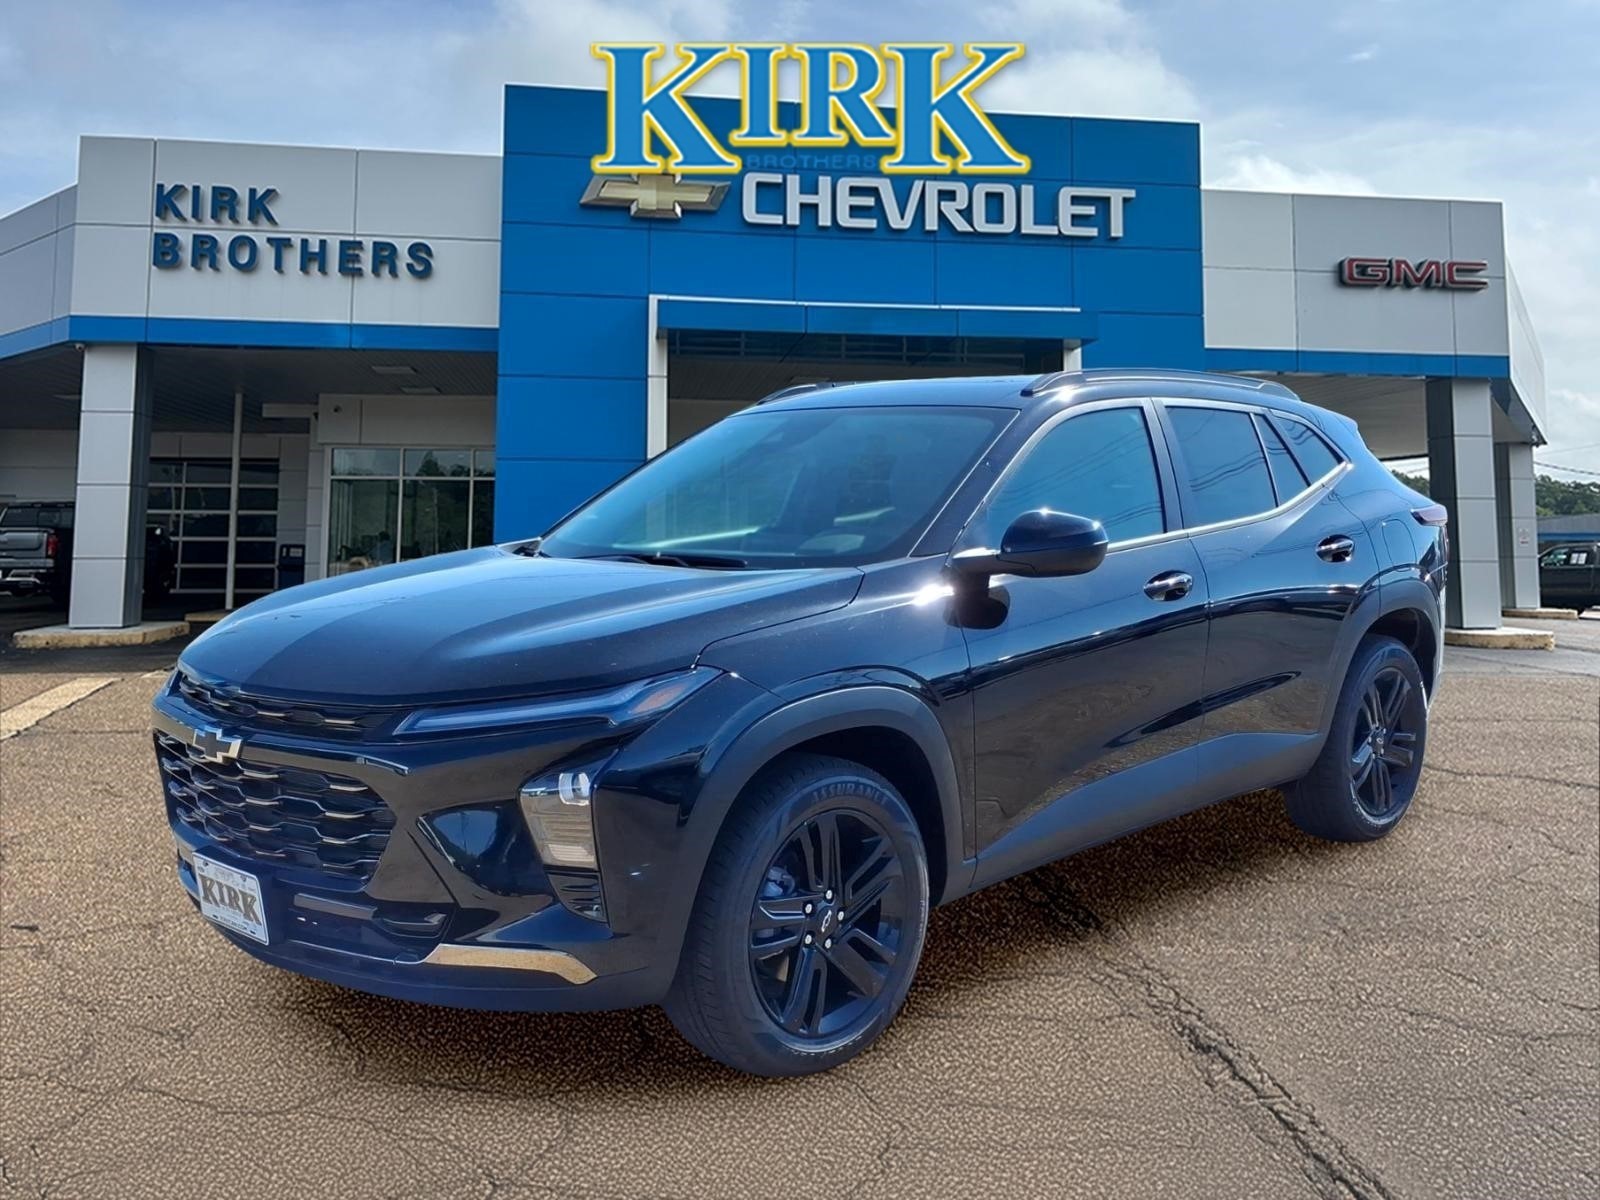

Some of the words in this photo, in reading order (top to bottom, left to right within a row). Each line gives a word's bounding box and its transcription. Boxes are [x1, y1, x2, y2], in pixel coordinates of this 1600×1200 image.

[154, 183, 279, 226] KIRK
[742, 173, 1136, 238] CHEVROLET
[152, 232, 434, 279] BROTHERS
[1338, 257, 1489, 290] GMC
[198, 873, 262, 926] KIRK
